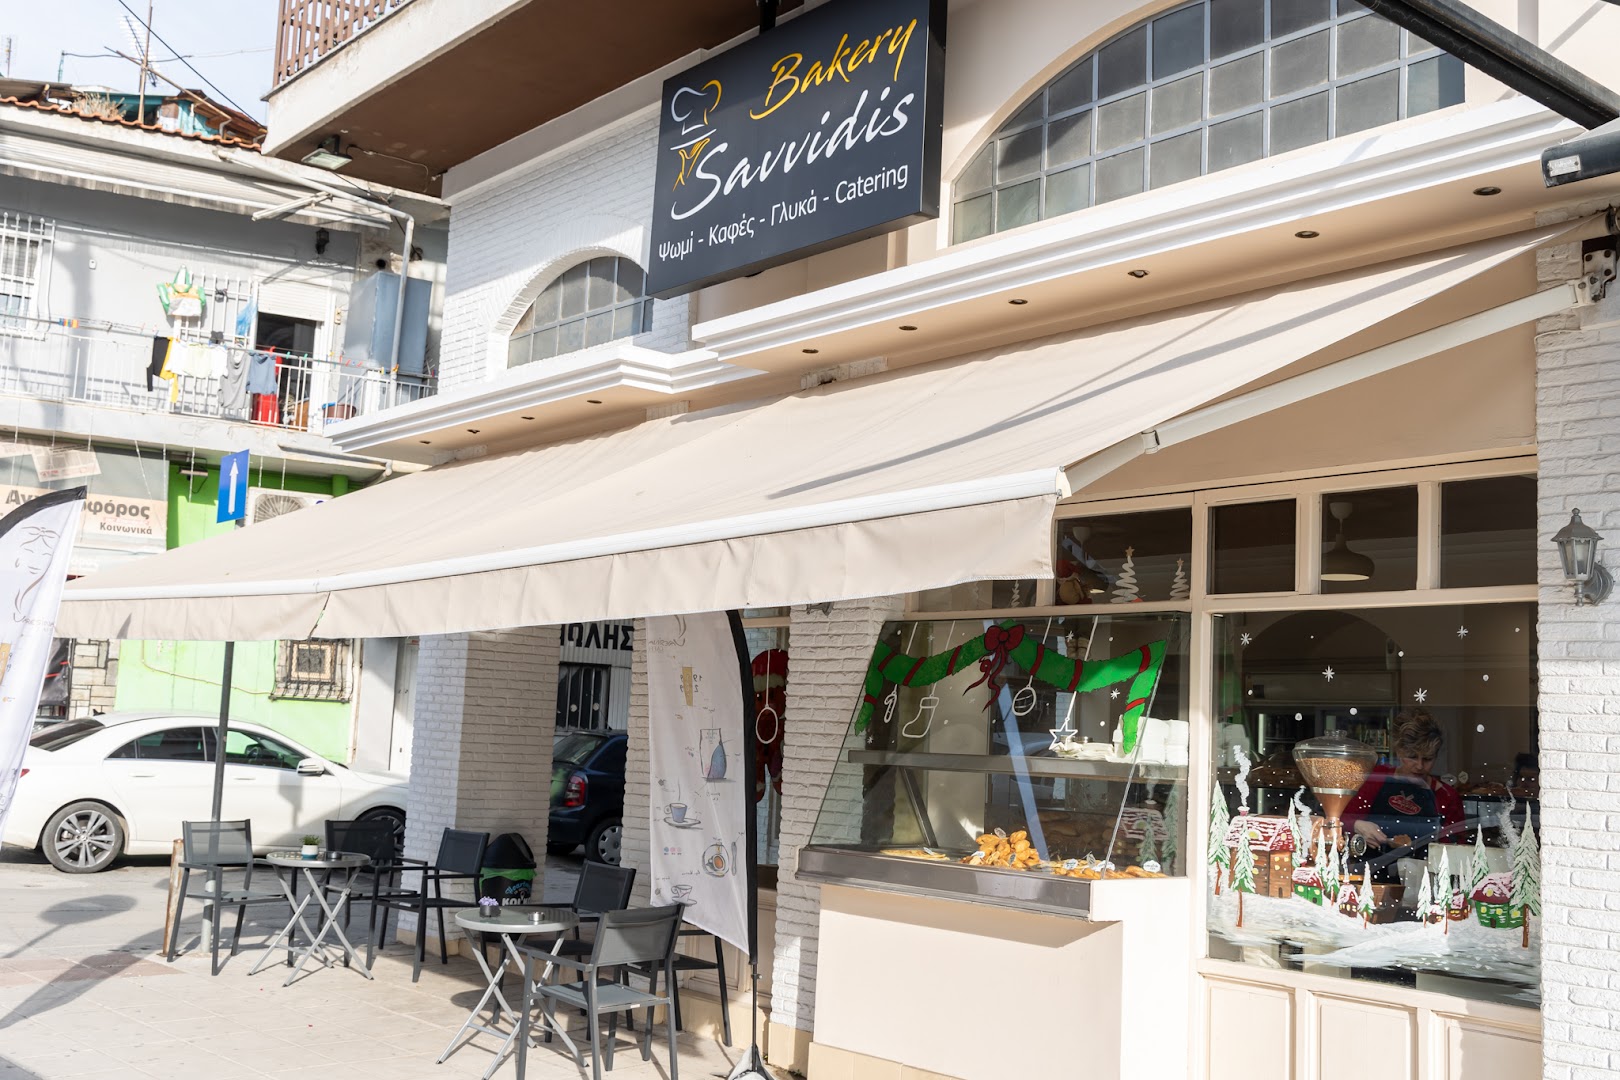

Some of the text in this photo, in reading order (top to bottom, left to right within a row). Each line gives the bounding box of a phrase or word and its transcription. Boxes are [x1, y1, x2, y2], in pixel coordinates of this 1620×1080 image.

[749, 18, 918, 121] Bakery
[670, 86, 915, 221] Savvidis
[708, 213, 755, 247] Καφές
[770, 189, 817, 227] Γλυκά
[835, 164, 909, 204] Catering
[99, 521, 153, 536] Κοινωνικά
